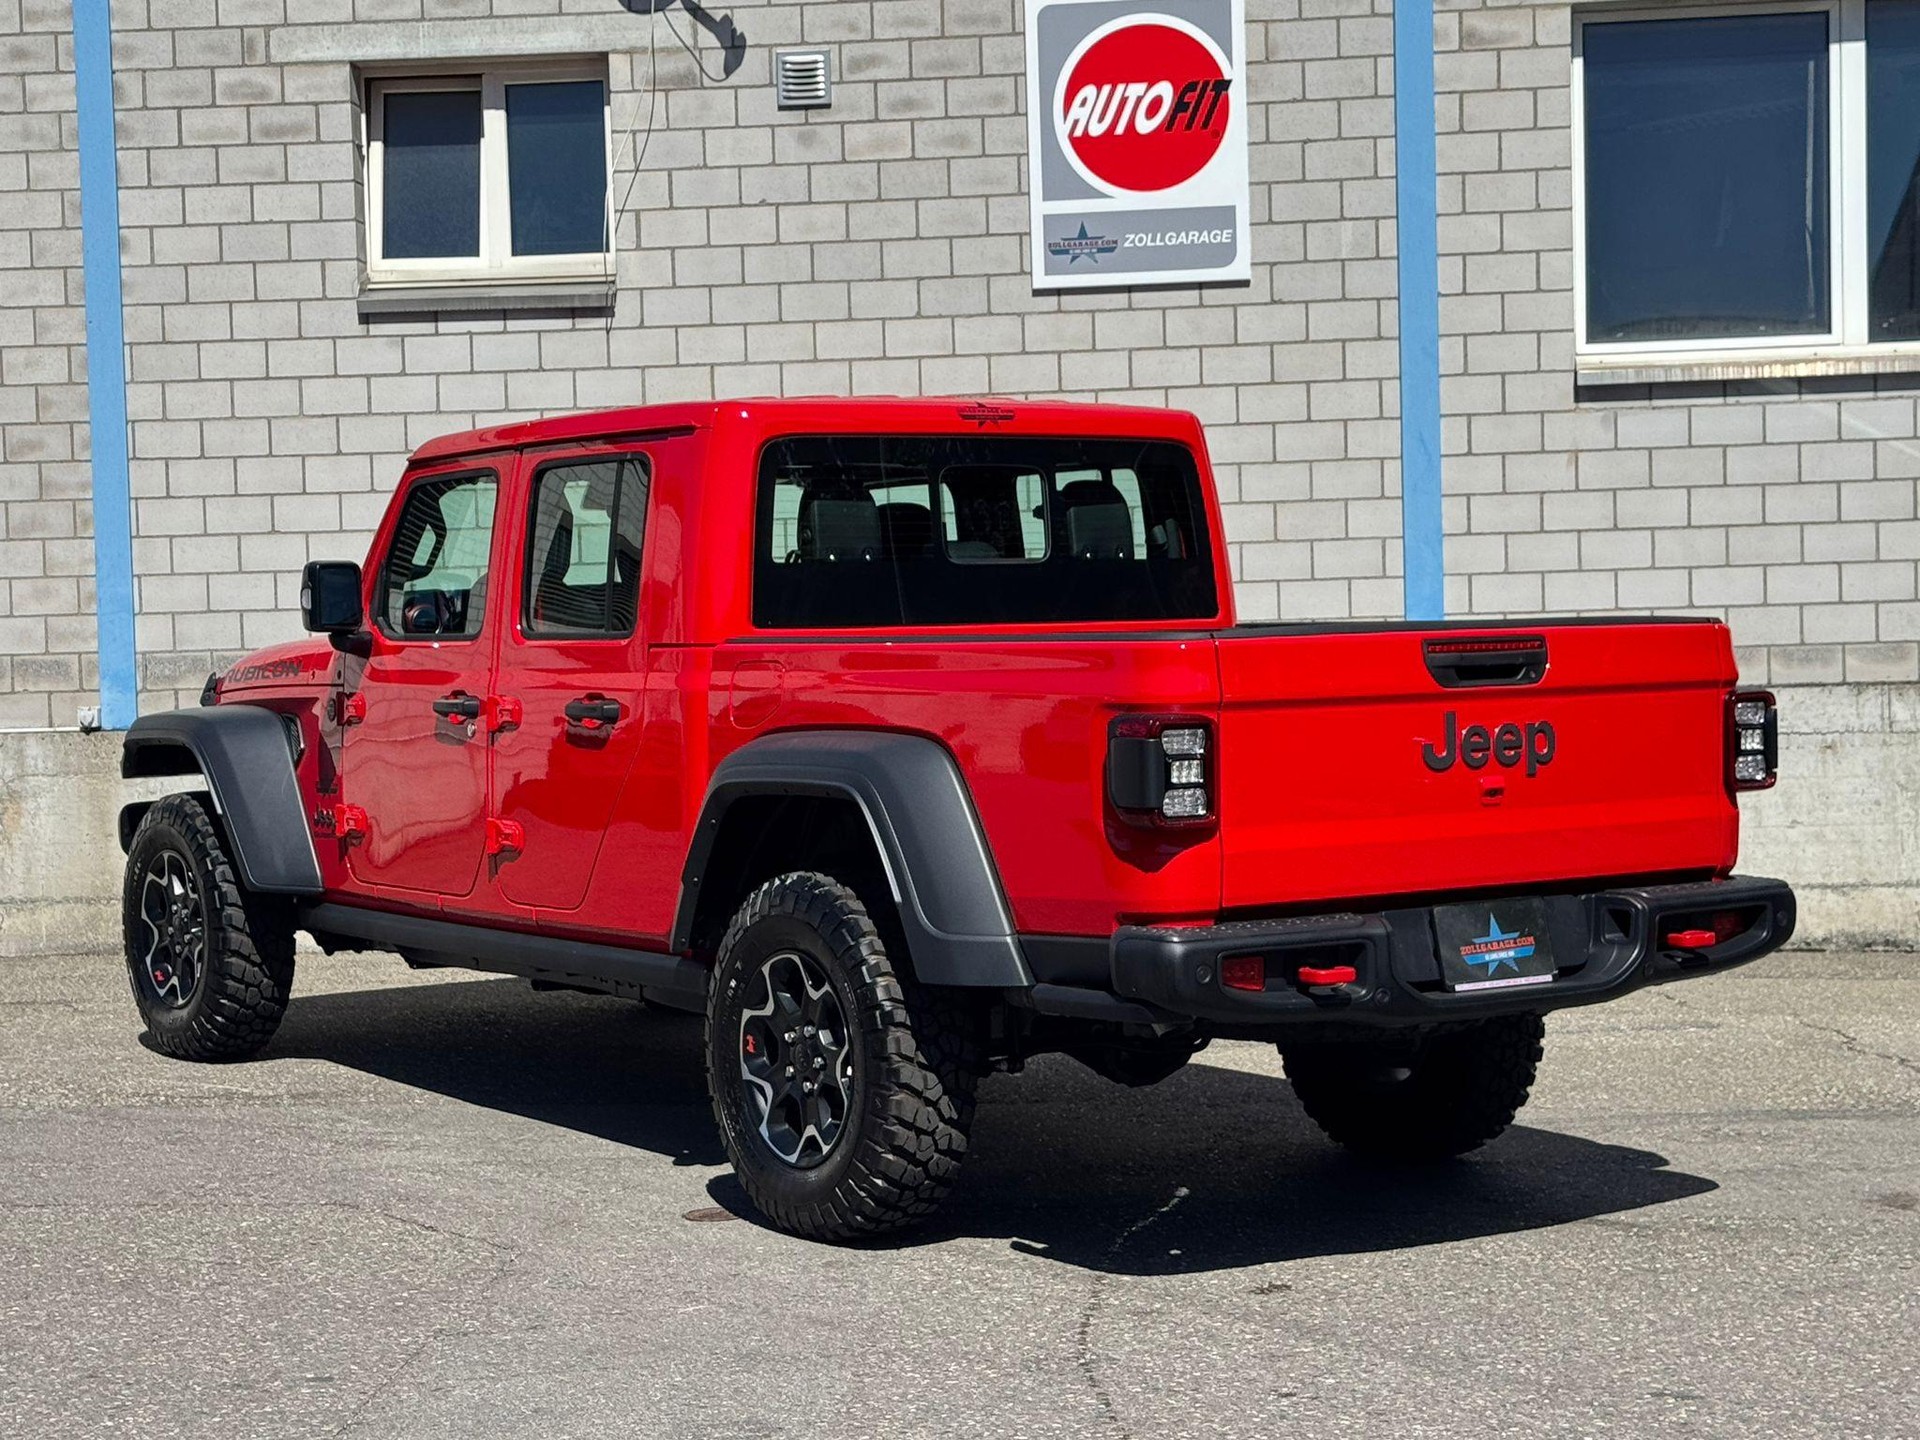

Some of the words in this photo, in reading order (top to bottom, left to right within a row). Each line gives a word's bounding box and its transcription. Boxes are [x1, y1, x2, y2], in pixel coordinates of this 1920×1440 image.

[1123, 229, 1233, 248] ZOLLGARAGE
[225, 658, 303, 683] RUBICON
[1422, 711, 1556, 778] Jeep
[1459, 936, 1536, 955] ZOLLGARAGE.COM
